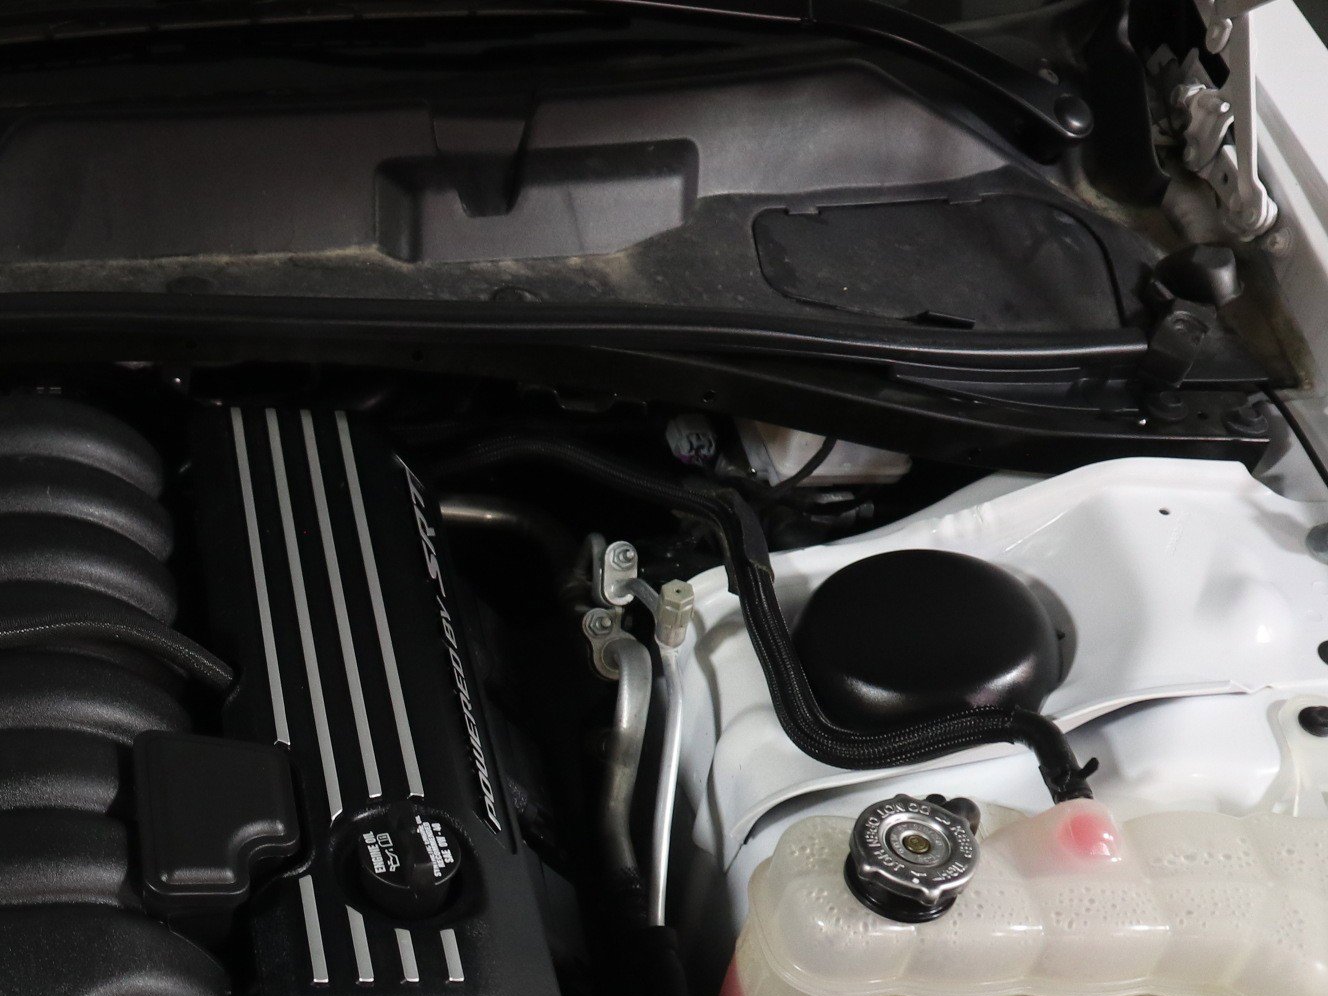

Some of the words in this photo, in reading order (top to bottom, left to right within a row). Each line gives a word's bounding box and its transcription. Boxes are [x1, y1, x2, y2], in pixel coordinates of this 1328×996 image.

[405, 466, 446, 597] SRT
[436, 595, 457, 649] BY
[449, 648, 501, 831] POWERED
[877, 804, 905, 818] NOT
[363, 831, 376, 844] OIL
[865, 816, 880, 847] OPEN
[367, 843, 386, 874] ENGINE
[441, 849, 454, 863] SAE
[874, 849, 904, 872] HOT
